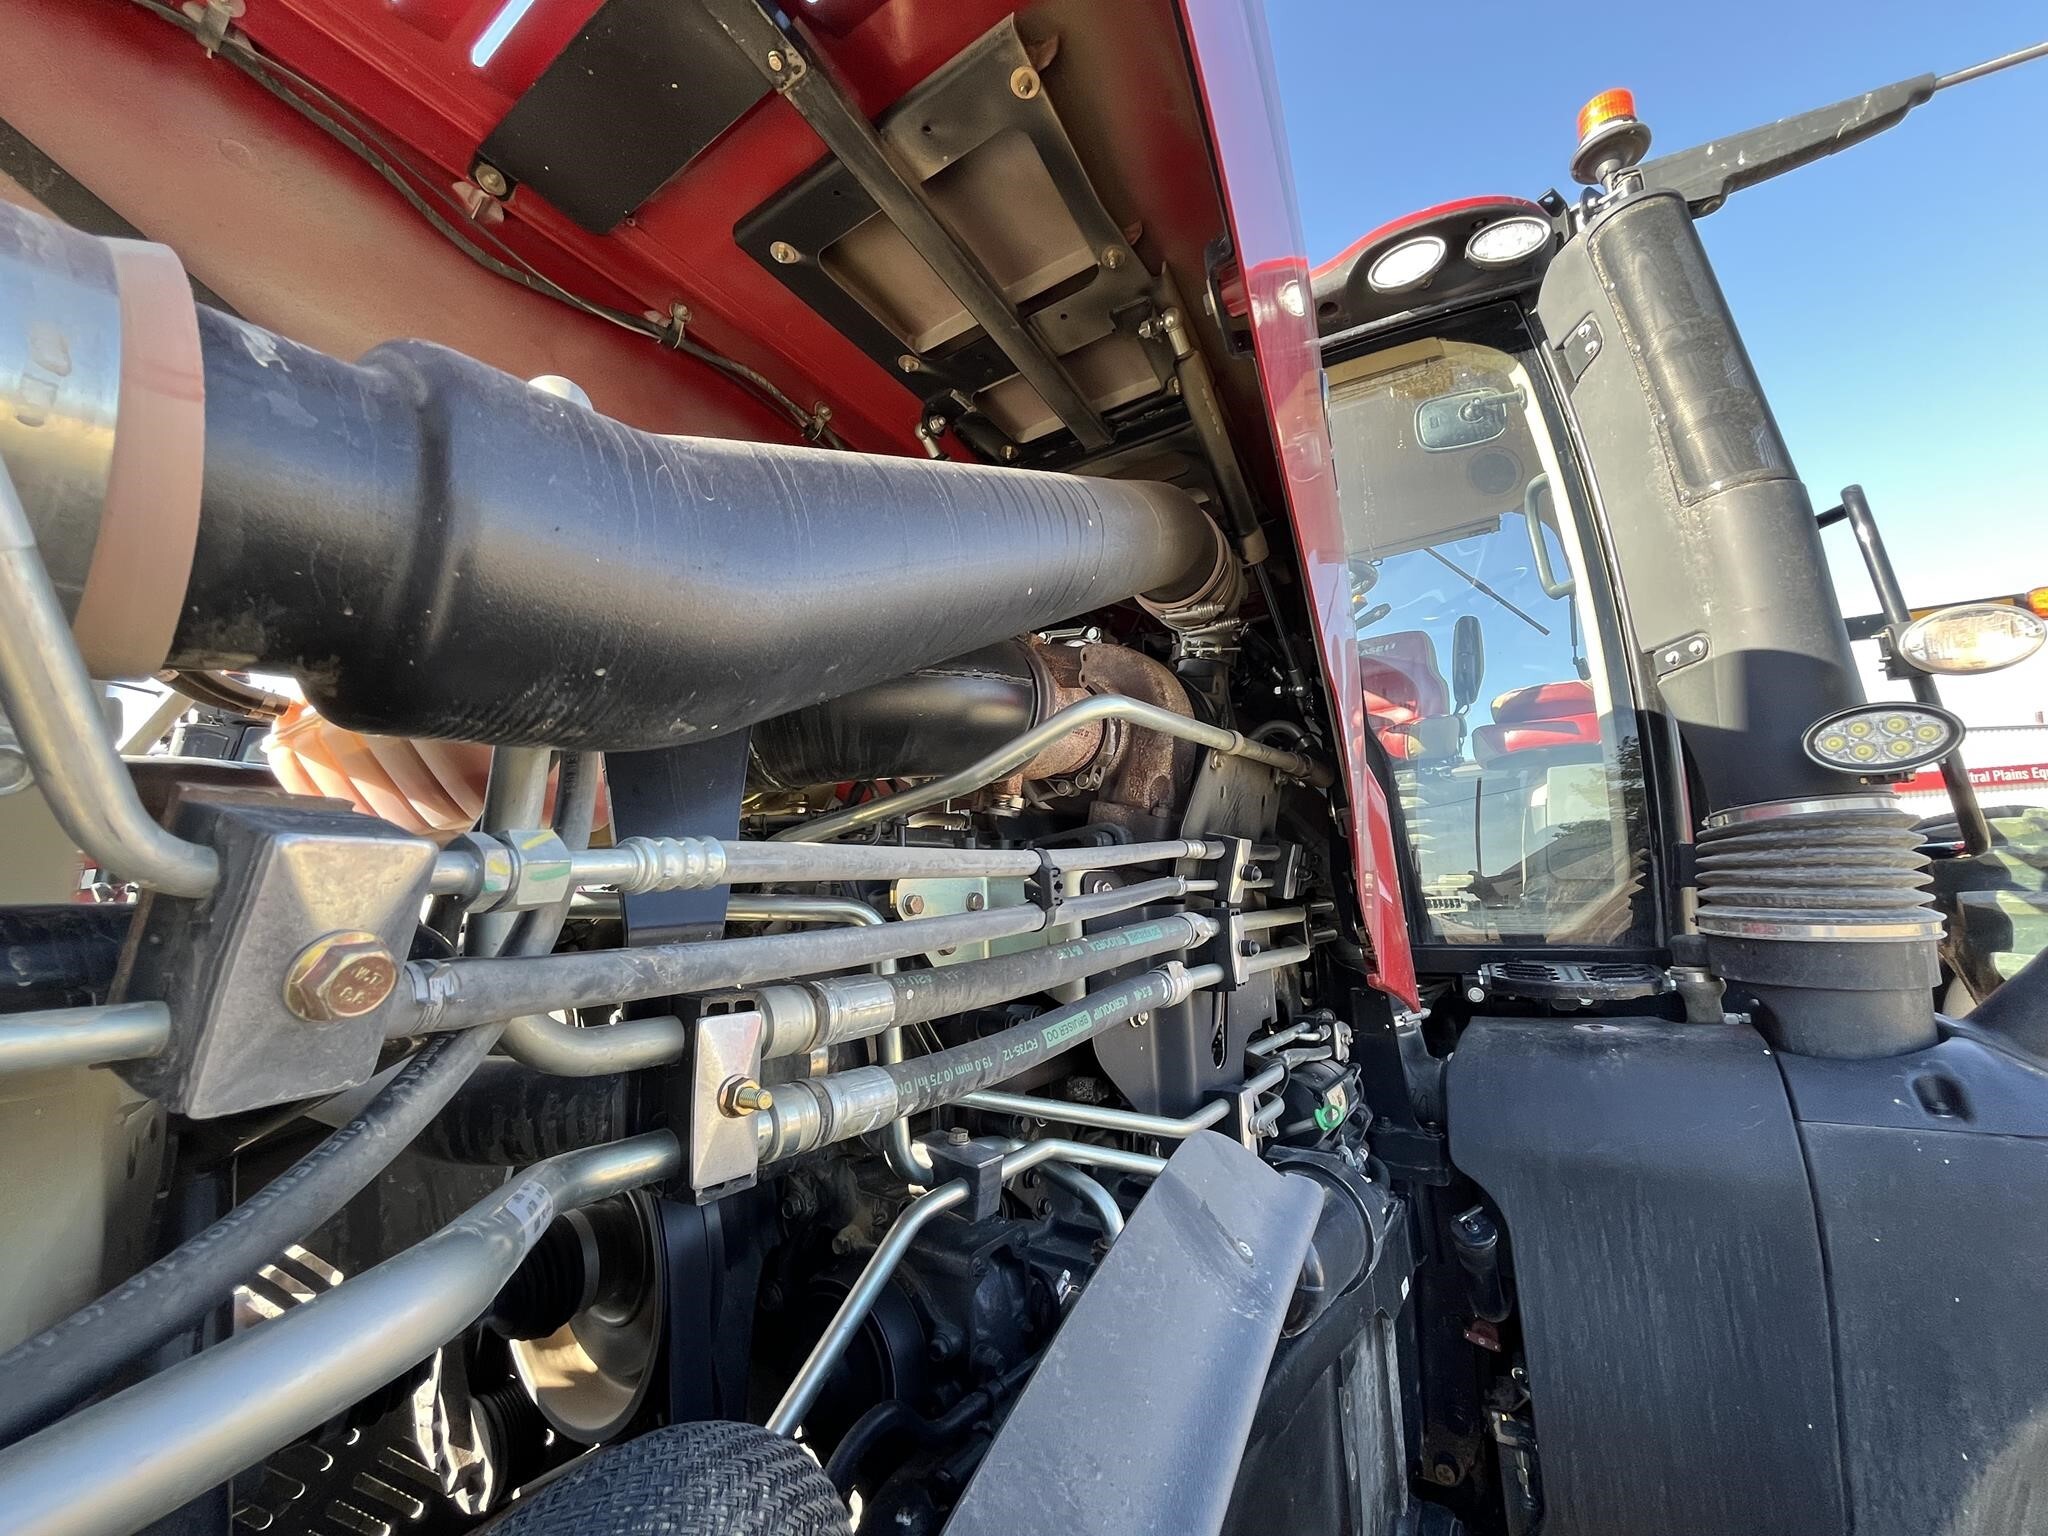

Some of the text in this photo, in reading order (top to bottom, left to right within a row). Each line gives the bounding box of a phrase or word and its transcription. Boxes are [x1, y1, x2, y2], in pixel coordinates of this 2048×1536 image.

[1968, 771, 1991, 783] tral
[1992, 768, 2029, 782] Plains
[1093, 994, 1128, 1020] AEROQUIP
[1060, 1014, 1089, 1039] BRUISER
[1002, 1038, 1039, 1062] FC735-12
[955, 1064, 974, 1076] mm
[975, 1055, 993, 1072] 19.0
